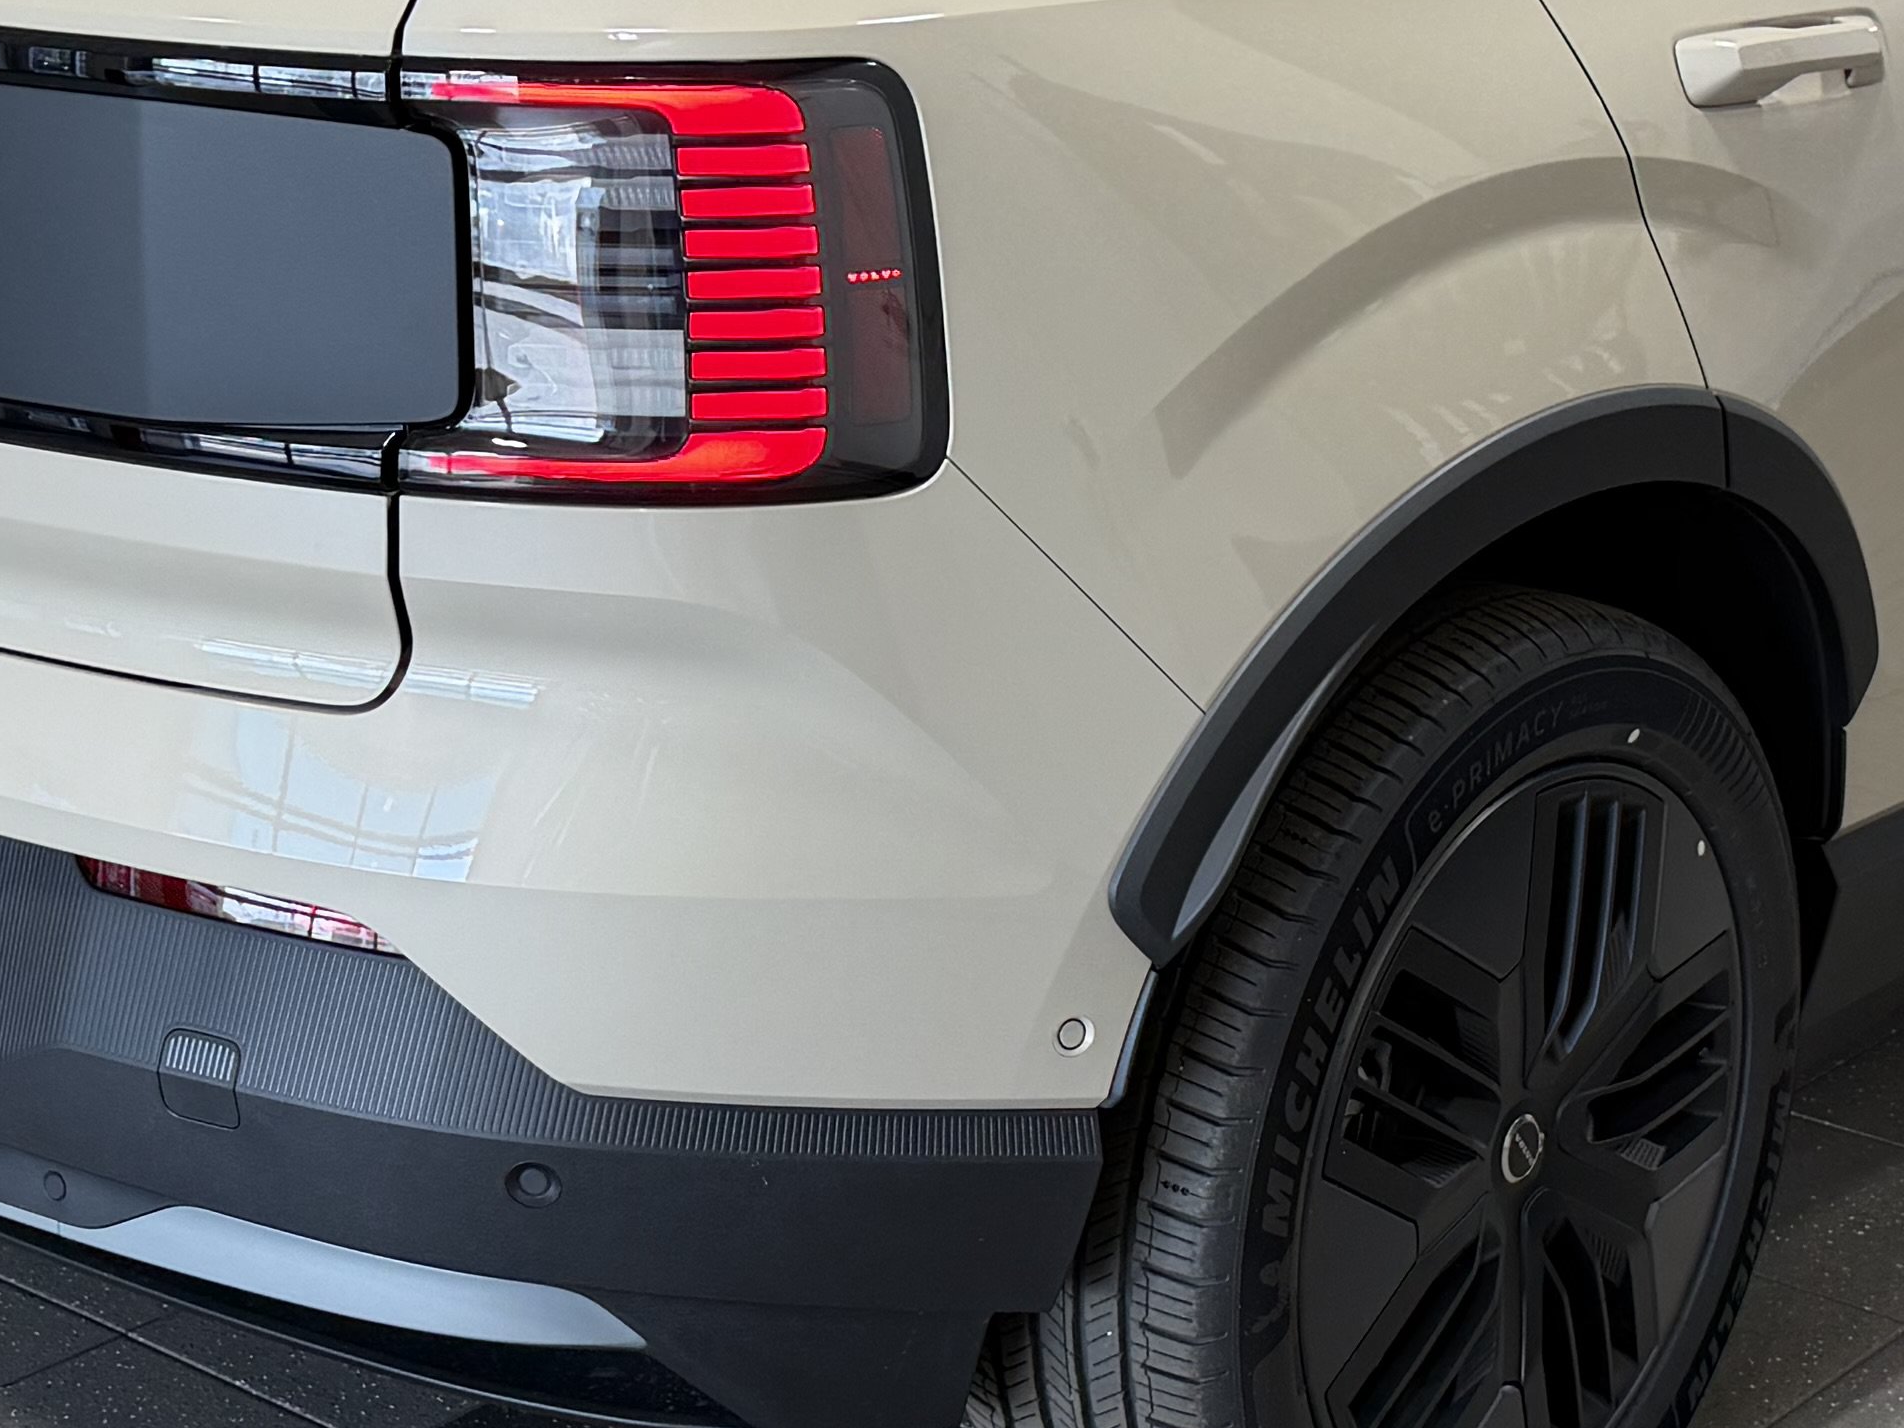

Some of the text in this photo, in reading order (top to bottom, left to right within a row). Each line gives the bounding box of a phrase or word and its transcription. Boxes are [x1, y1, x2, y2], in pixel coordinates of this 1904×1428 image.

[847, 268, 902, 284] VOLVO
[1261, 855, 1401, 1238] MICHELIN
[1686, 1090, 1793, 1414] MICHELIN
